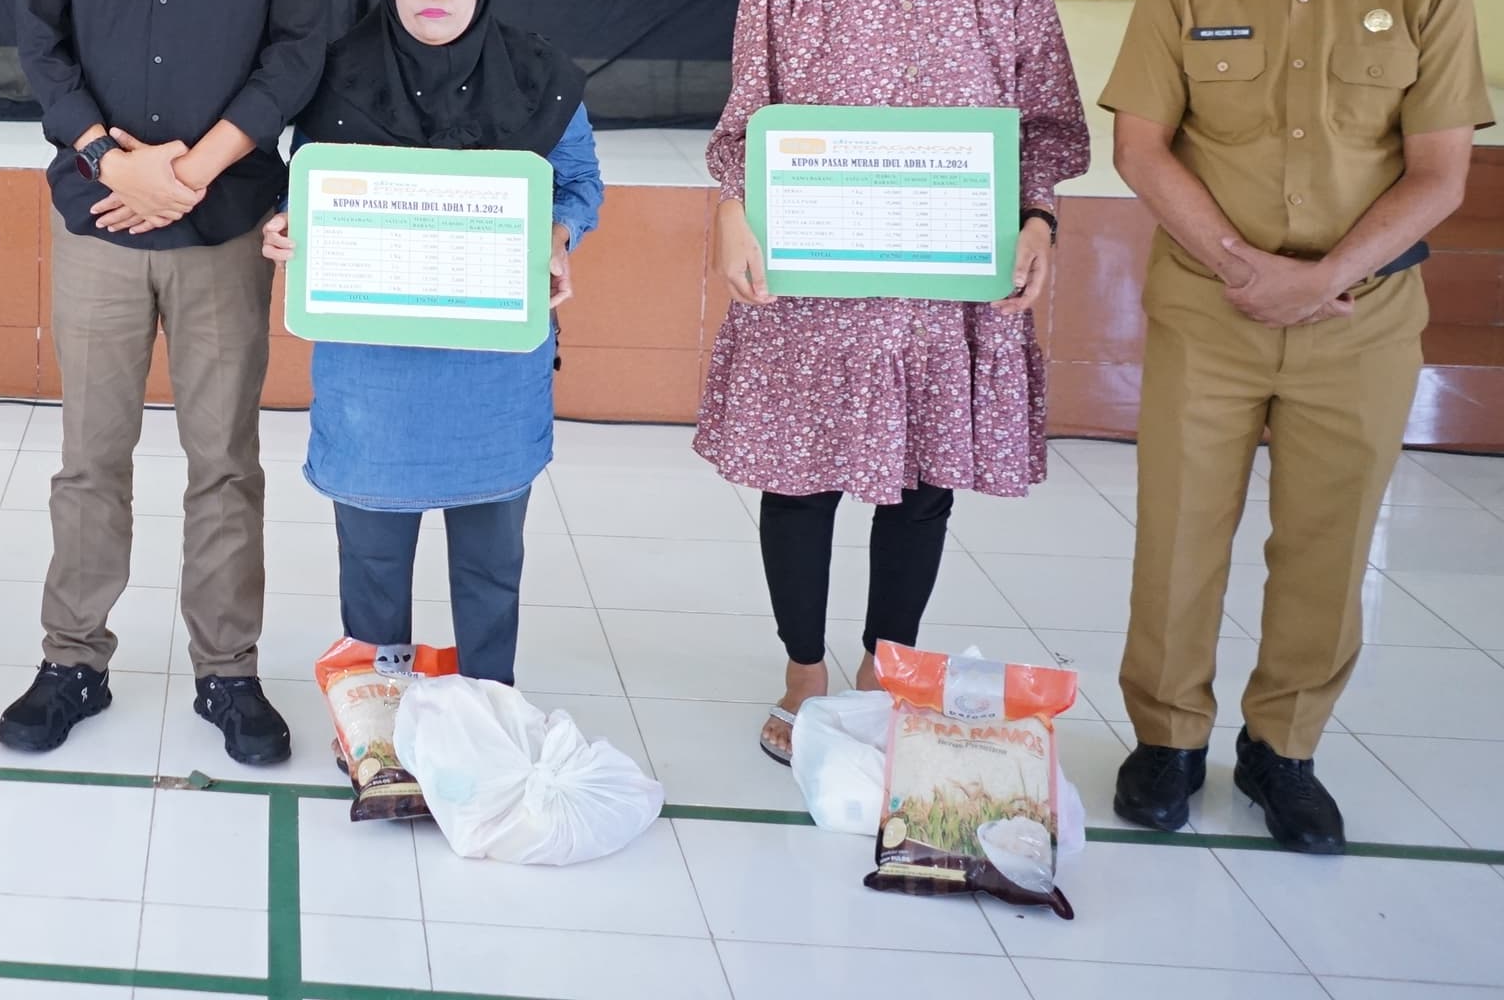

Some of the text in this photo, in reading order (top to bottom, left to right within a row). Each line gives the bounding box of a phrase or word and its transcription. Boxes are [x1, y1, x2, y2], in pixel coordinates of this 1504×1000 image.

[791, 157, 819, 167] KUPON
[821, 158, 849, 167] PASAR
[851, 158, 880, 168] MURAH
[903, 159, 927, 169] ADHA
[929, 159, 969, 169] T.A.2024
[332, 198, 505, 214] KUPON PASAR MURAH IDUL ADHA T.A.2024
[346, 683, 401, 702] SETRA
[904, 715, 1045, 756] SETRA RAMOS
